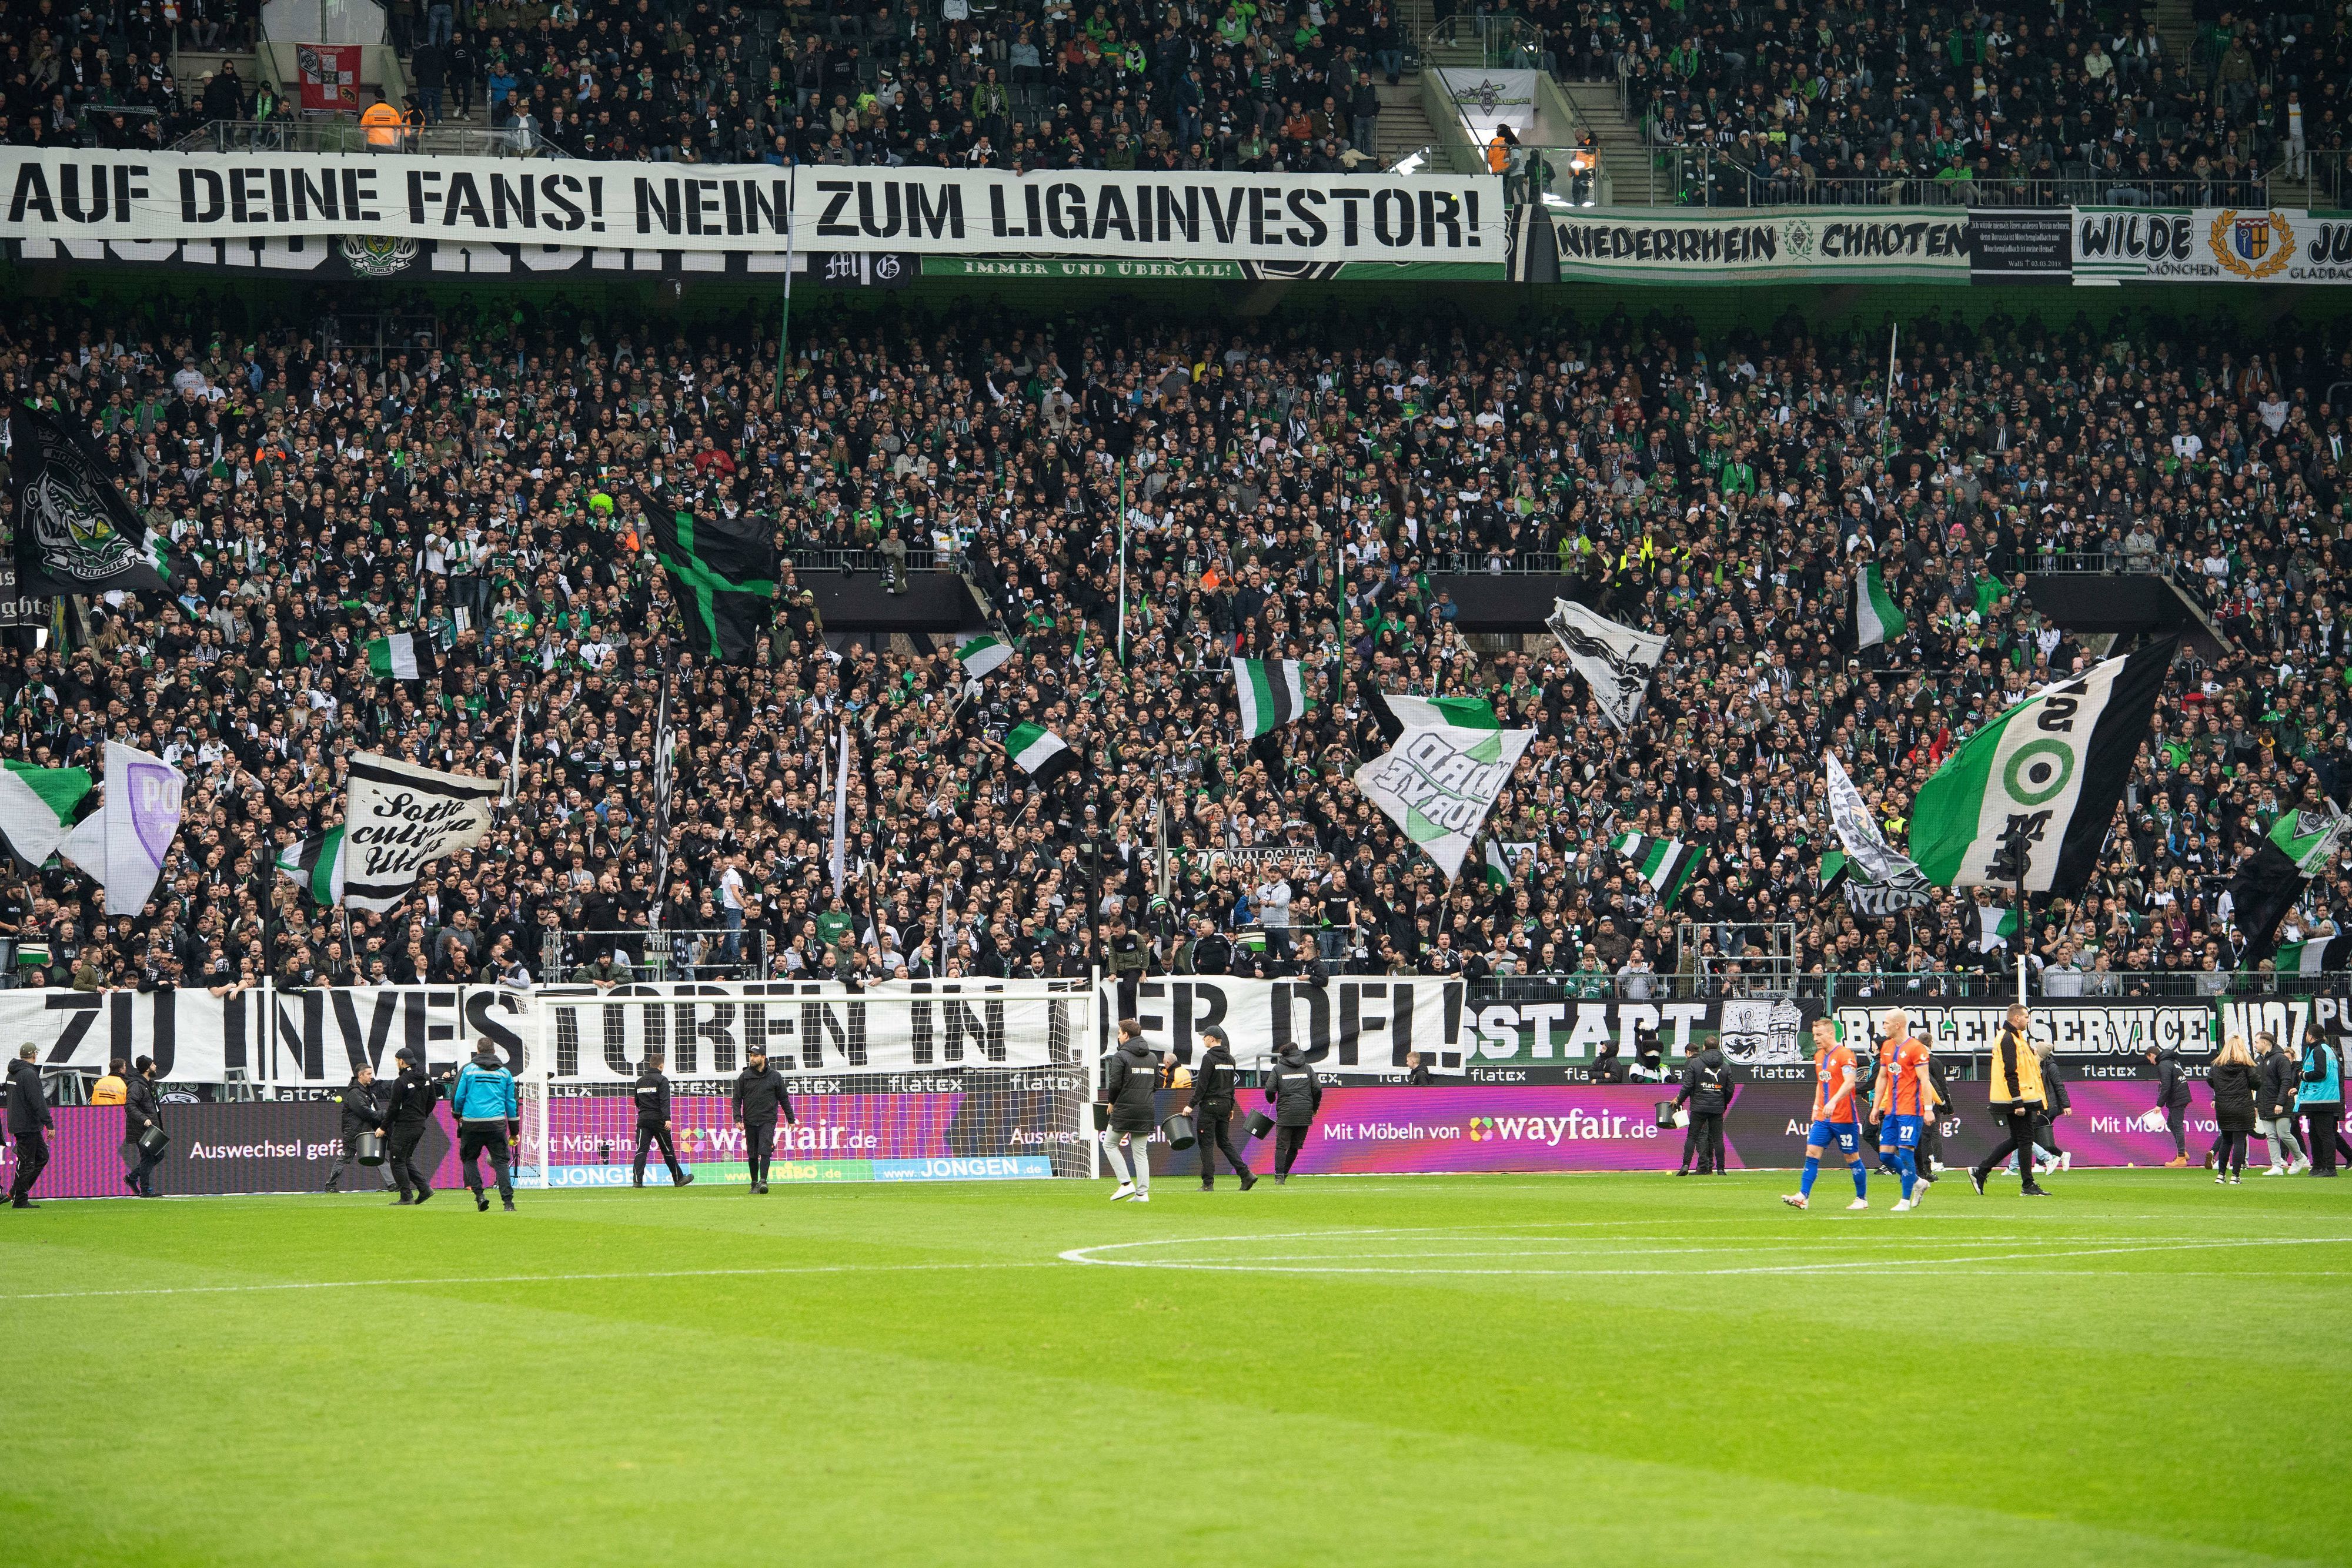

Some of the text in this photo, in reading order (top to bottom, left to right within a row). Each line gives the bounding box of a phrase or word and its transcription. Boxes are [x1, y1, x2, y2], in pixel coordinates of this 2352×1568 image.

[8, 163, 1481, 248] AUF DEINE FANS! NEIN ZUM LIGAINVESTOR!
[1556, 223, 1970, 263] NIEDERRHEIN CHAOTEN
[1992, 233, 2009, 241] Borussia
[2015, 233, 2051, 242] Mönchengladbach
[2080, 213, 2194, 261] WILDE
[1984, 245, 2020, 253] Mönchengladbach
[964, 260, 1232, 277] IMMER UND ÜBERALL!
[2146, 262, 2220, 277] MÖNCHEN
[43, 991, 175, 1080] ZU
[223, 984, 867, 1081] INVESTOREN
[911, 983, 1006, 1064] IN
[1271, 982, 1464, 1068] DFL!
[1464, 1003, 1707, 1059] START
[1471, 1068, 1526, 1082] flatex
[1750, 1065, 1806, 1079] flatex
[2082, 1065, 2137, 1077] flatex
[888, 1075, 963, 1092] flatex
[1010, 1073, 1083, 1091] flatex
[1324, 1108, 1658, 1146] Mit Möbeln von wayfair.de
[1900, 1126, 1913, 1139] 27
[2091, 1116, 2121, 1134] Mit
[1840, 1134, 1853, 1146] 32
[189, 1139, 301, 1159] Auswechsel
[823, 1168, 841, 1178] .de
[883, 1158, 1042, 1178] www. JONGEN .de
